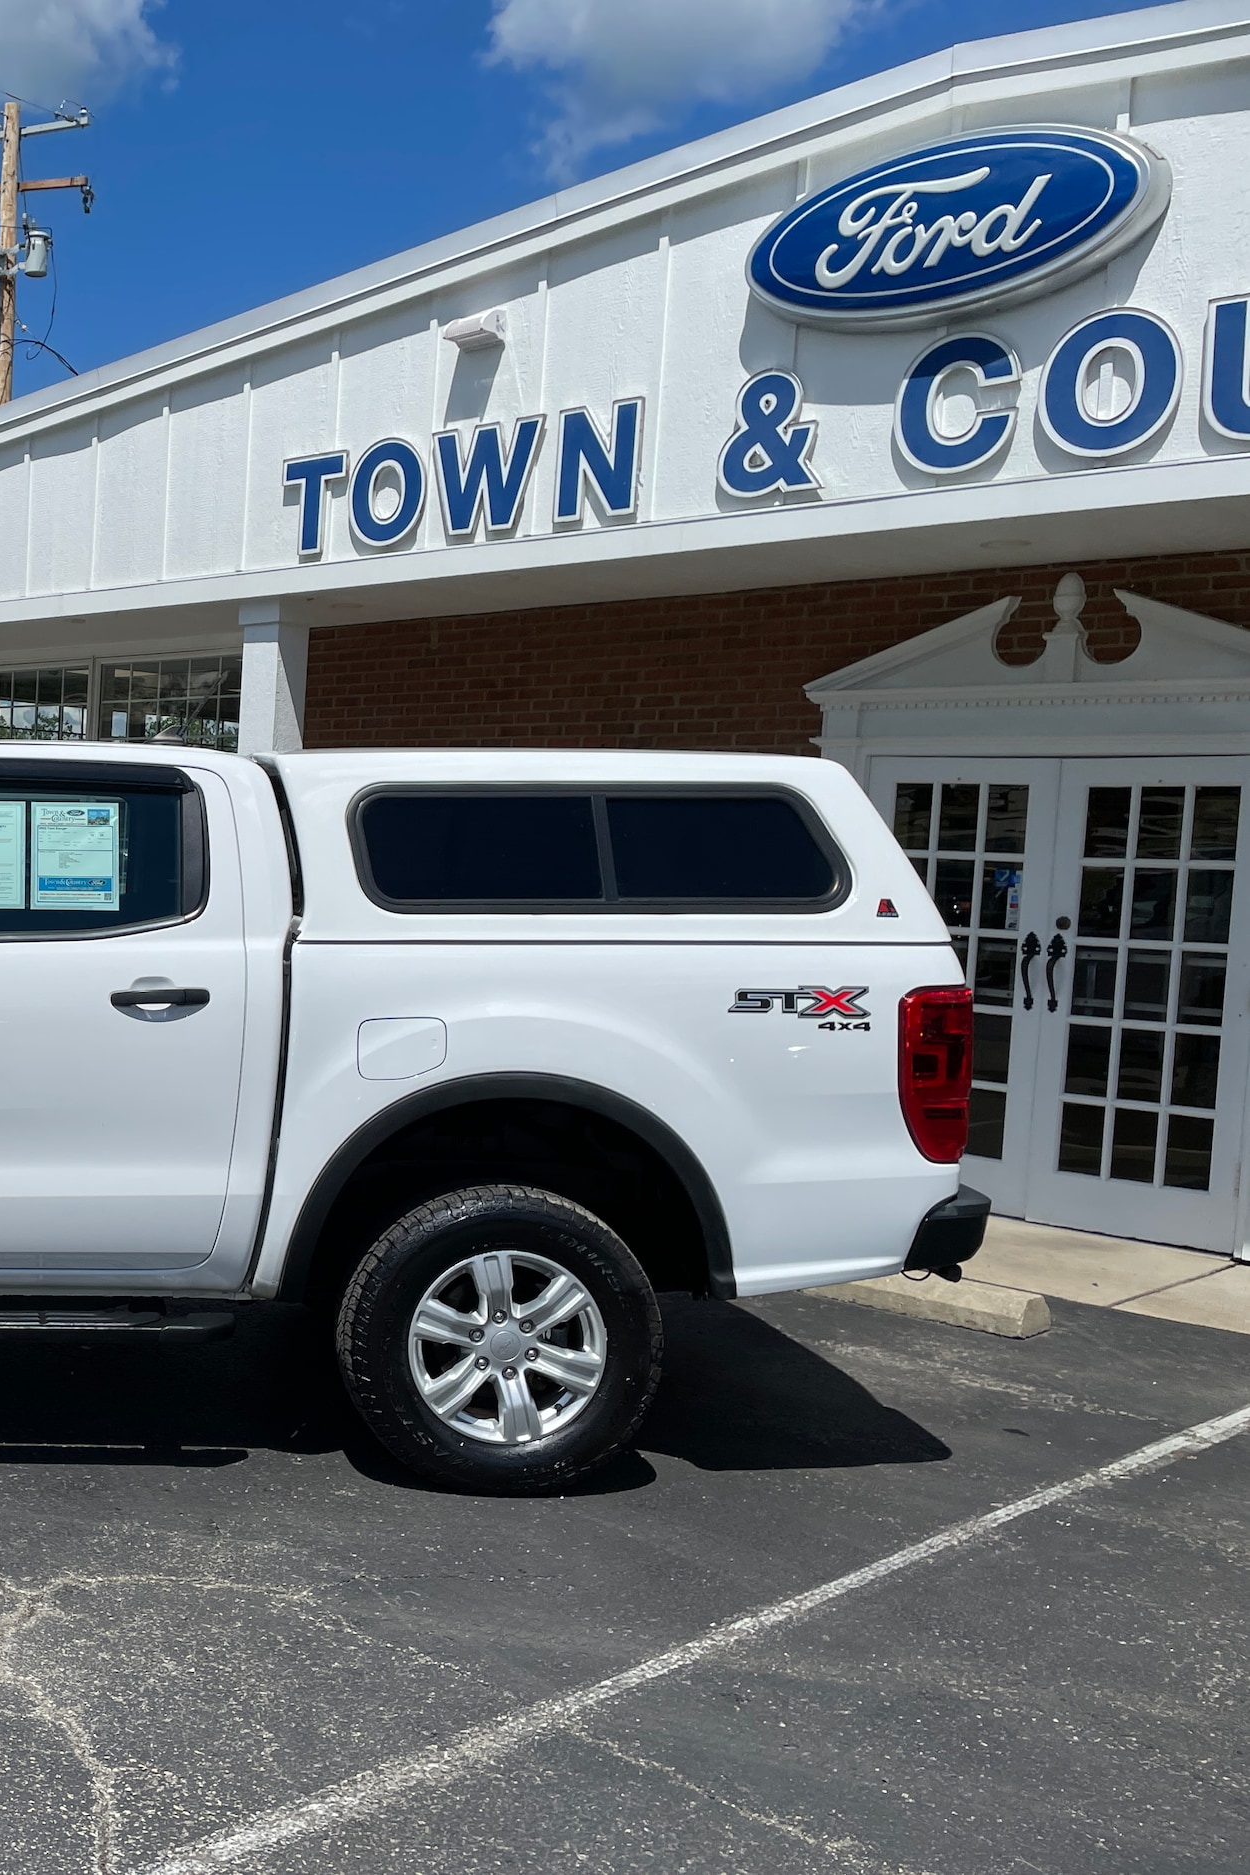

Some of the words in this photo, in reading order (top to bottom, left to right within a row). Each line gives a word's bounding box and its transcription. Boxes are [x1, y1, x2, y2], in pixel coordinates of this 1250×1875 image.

[815, 165, 1053, 291] Ford
[283, 396, 644, 558] TOWN
[718, 367, 824, 499] &
[727, 985, 872, 1019] STX
